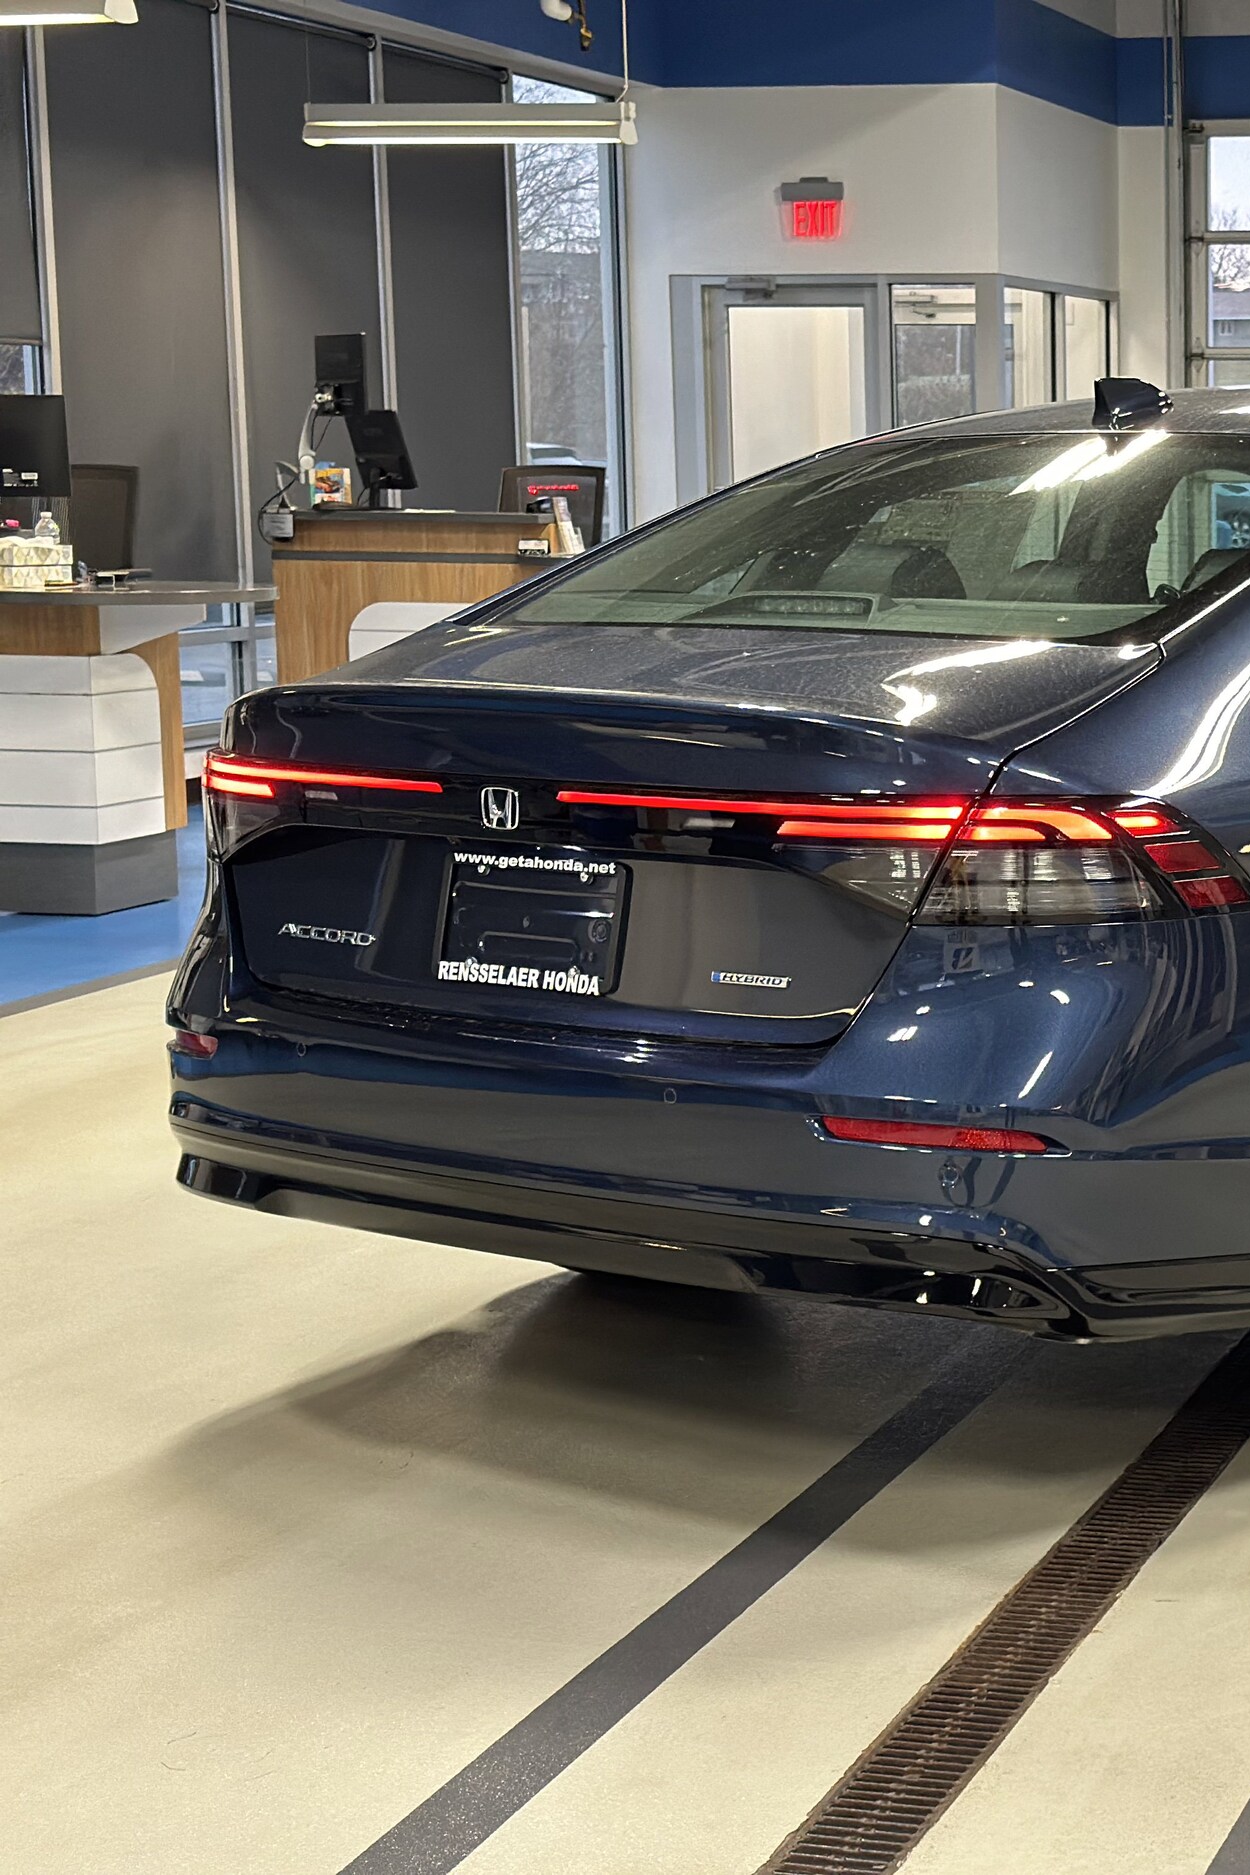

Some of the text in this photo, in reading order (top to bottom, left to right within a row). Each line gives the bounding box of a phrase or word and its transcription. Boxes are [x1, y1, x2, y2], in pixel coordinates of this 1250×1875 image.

[793, 201, 837, 236] EXIT
[454, 853, 616, 875] www.getahonda.net
[278, 923, 376, 946] ACCORD
[438, 960, 600, 996] RENSSELAER HONDA
[721, 973, 783, 986] HYBRID
